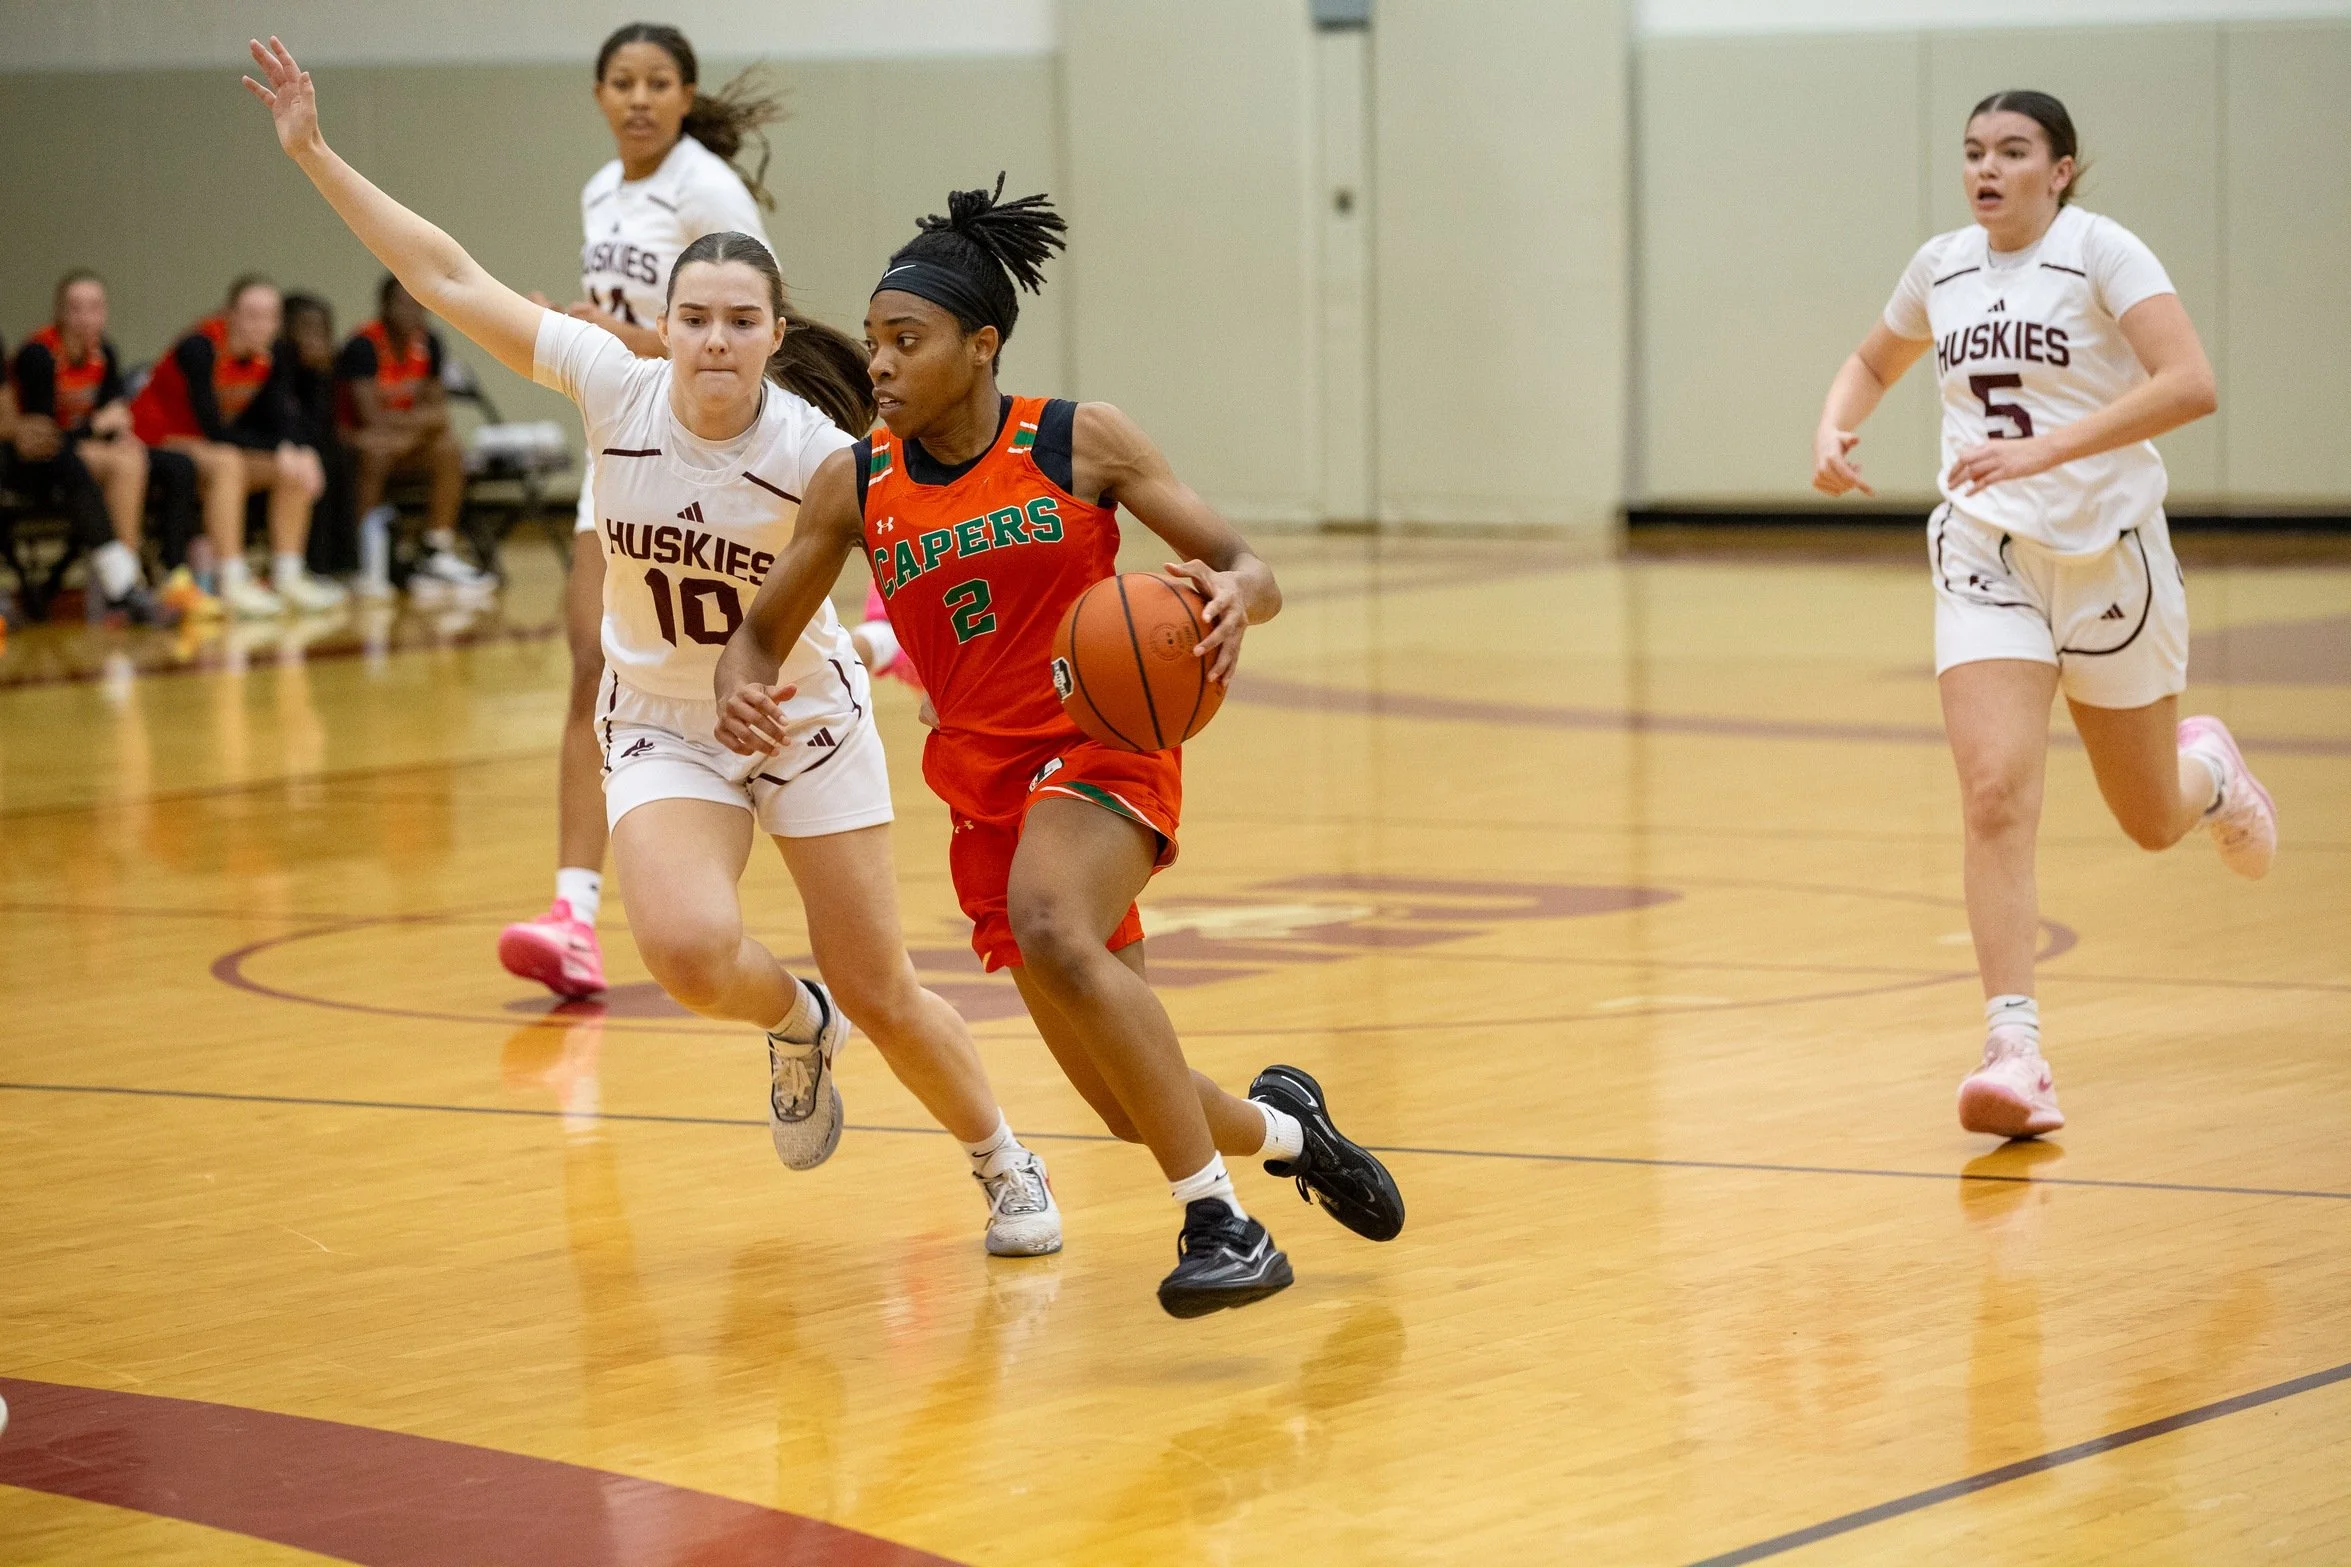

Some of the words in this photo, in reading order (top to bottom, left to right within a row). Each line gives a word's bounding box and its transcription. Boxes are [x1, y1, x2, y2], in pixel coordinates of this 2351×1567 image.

[1937, 321, 2070, 378] HUSKIES
[1968, 373, 2034, 439] 5
[606, 518, 775, 586] HUSKIES
[874, 496, 1064, 600] CAPERS
[644, 567, 744, 648] 10
[943, 577, 997, 645] 2
